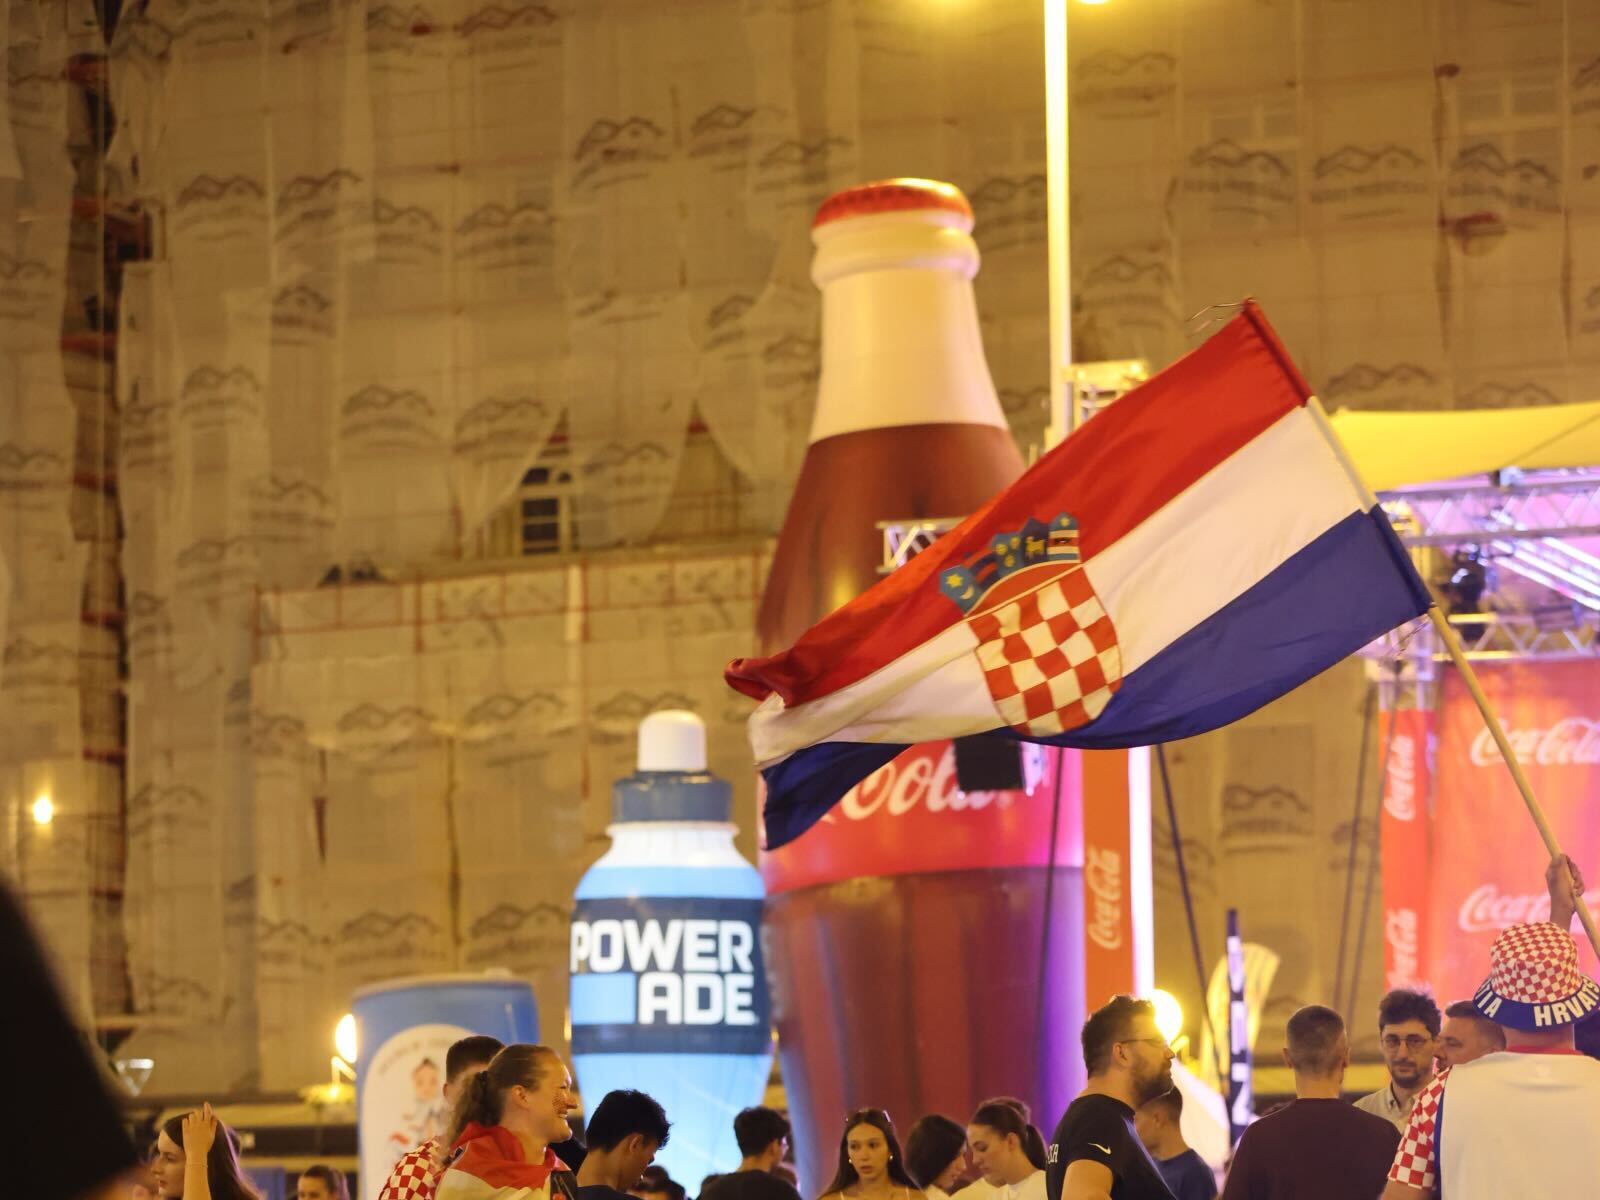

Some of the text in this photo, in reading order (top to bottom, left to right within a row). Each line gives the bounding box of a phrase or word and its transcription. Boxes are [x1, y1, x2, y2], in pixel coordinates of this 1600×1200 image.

[1086, 844, 1122, 950] Coca-Cola
[570, 918, 754, 973] POWER
[637, 972, 757, 1026] ADE
